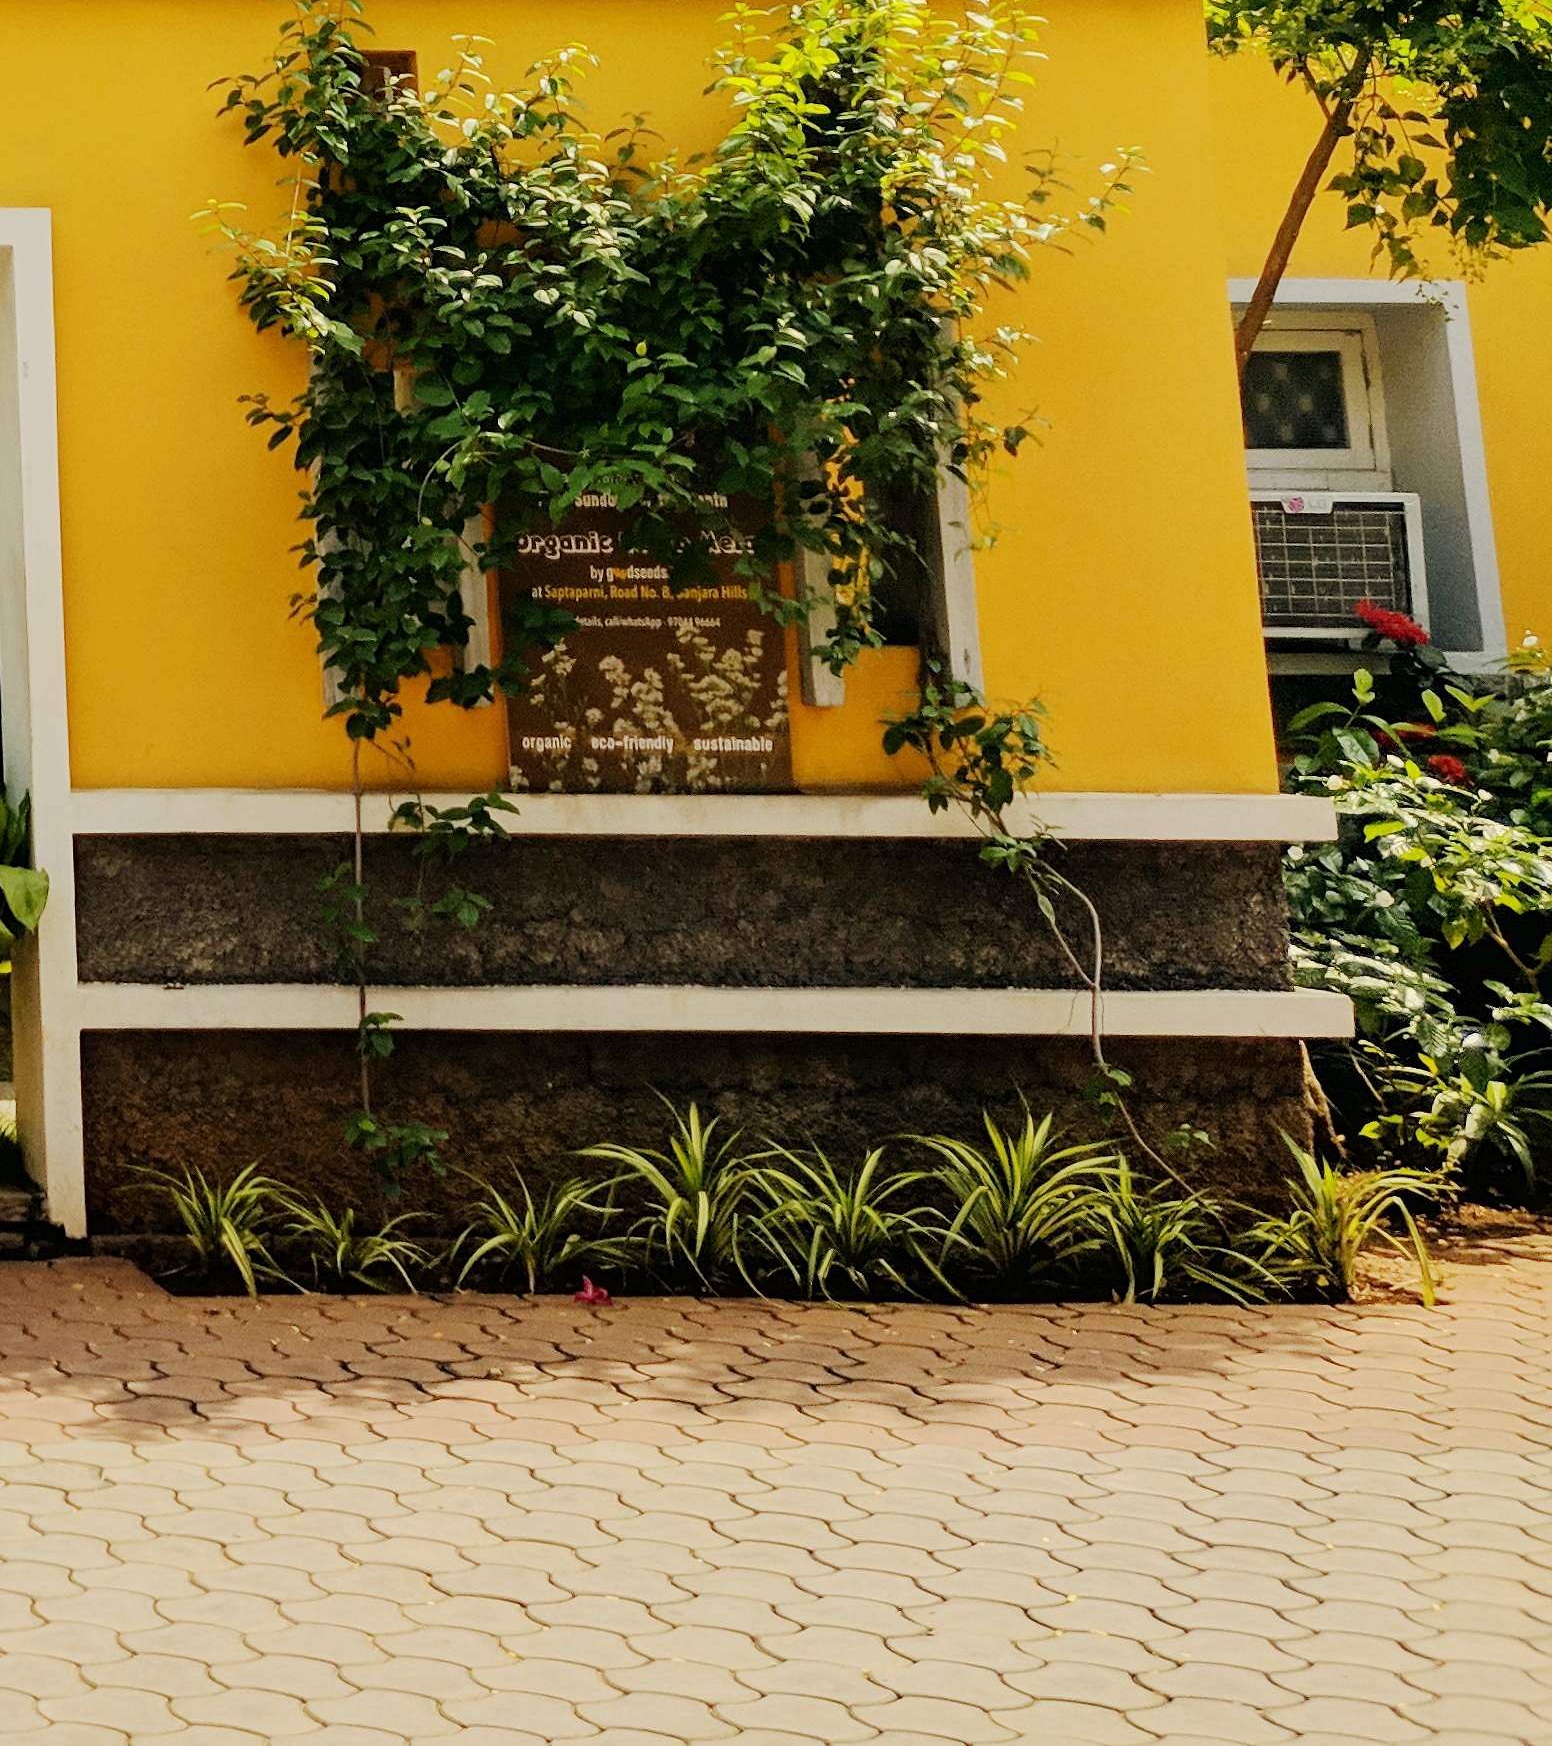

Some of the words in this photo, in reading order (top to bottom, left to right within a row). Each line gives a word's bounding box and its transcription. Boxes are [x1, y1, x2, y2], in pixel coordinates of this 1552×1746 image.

[574, 491, 618, 508] Sunda
[518, 531, 614, 560] organic
[590, 565, 604, 582] by
[532, 585, 542, 598] at
[544, 584, 608, 602] Saptaparni,
[610, 584, 638, 599] Road
[640, 584, 660, 599] No.
[721, 584, 748, 599] Hills
[522, 734, 572, 752] organic
[591, 734, 674, 754] eco-friendly
[693, 735, 774, 752] sustainable
